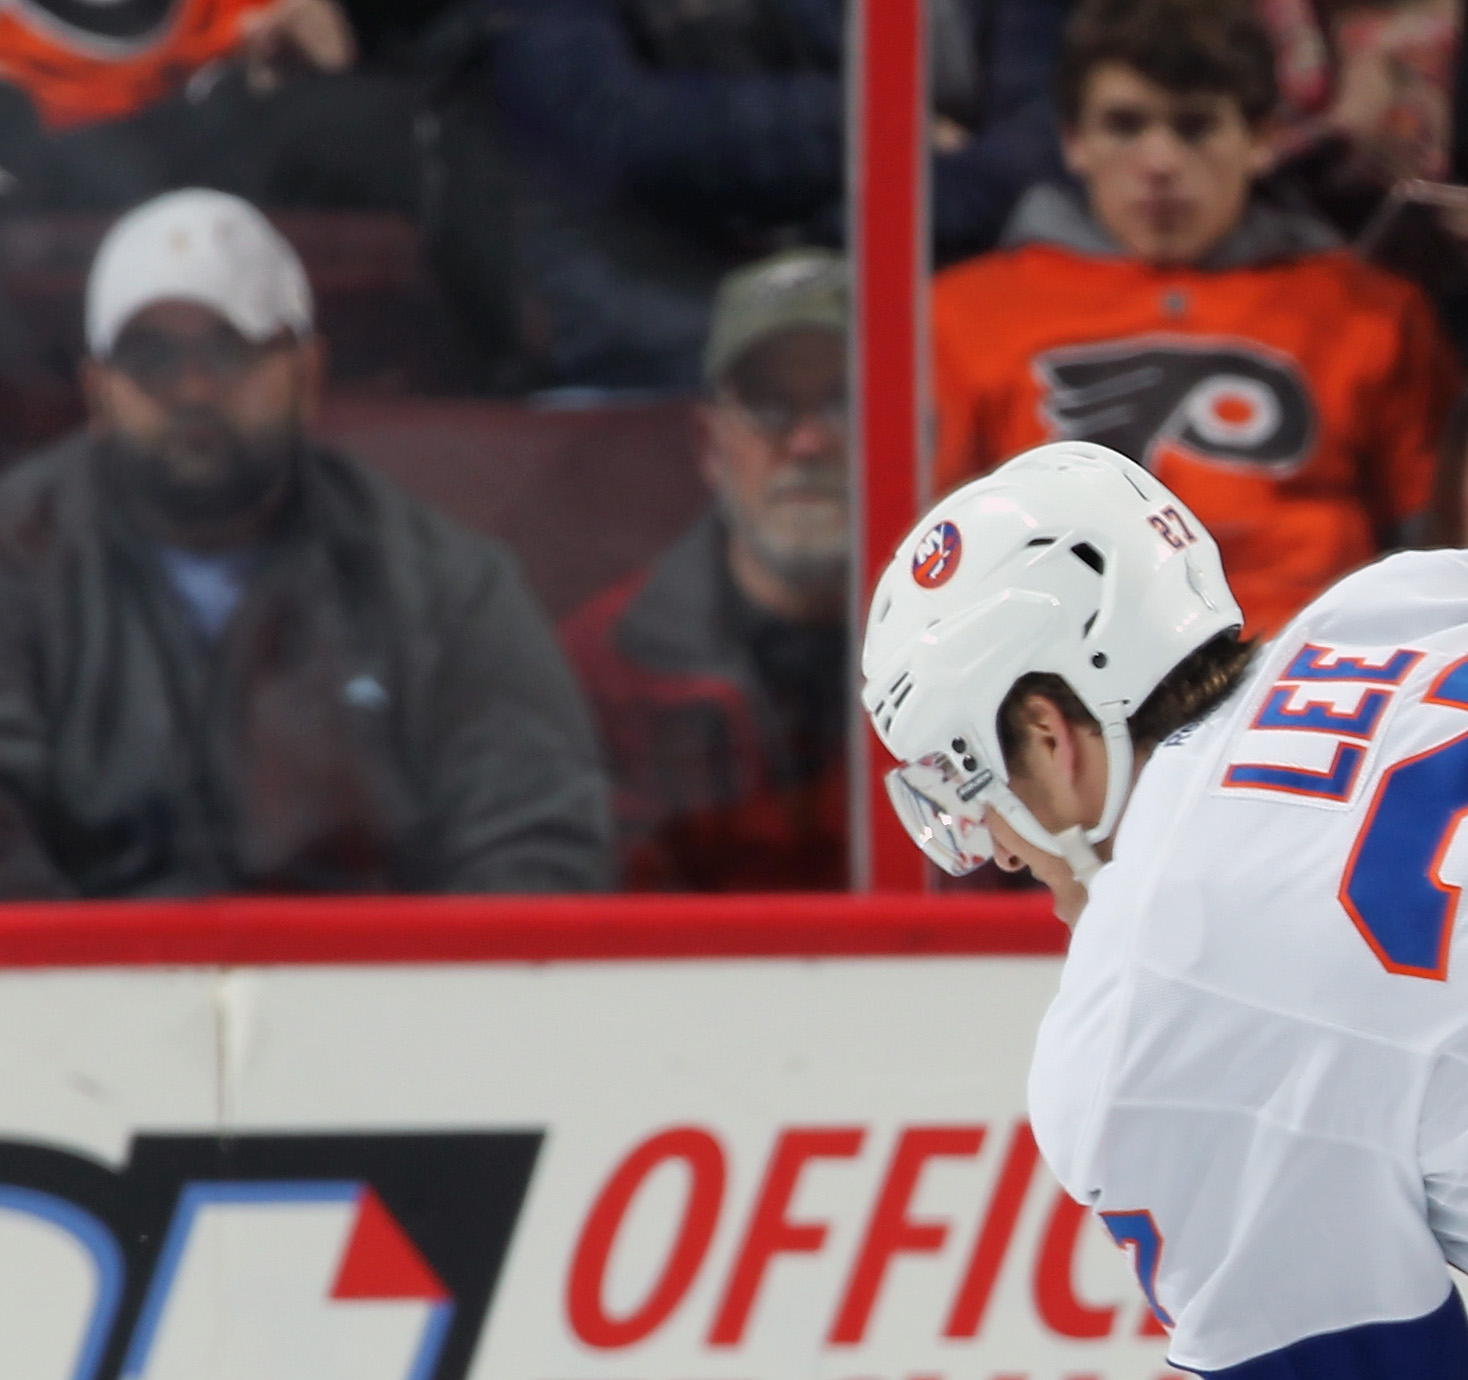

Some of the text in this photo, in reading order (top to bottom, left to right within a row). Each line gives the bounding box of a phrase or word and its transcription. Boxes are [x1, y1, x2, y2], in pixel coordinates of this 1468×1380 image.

[1147, 504, 1197, 552] 27
[1221, 642, 1427, 803] LEE
[563, 1122, 1172, 1350] OFFIC
